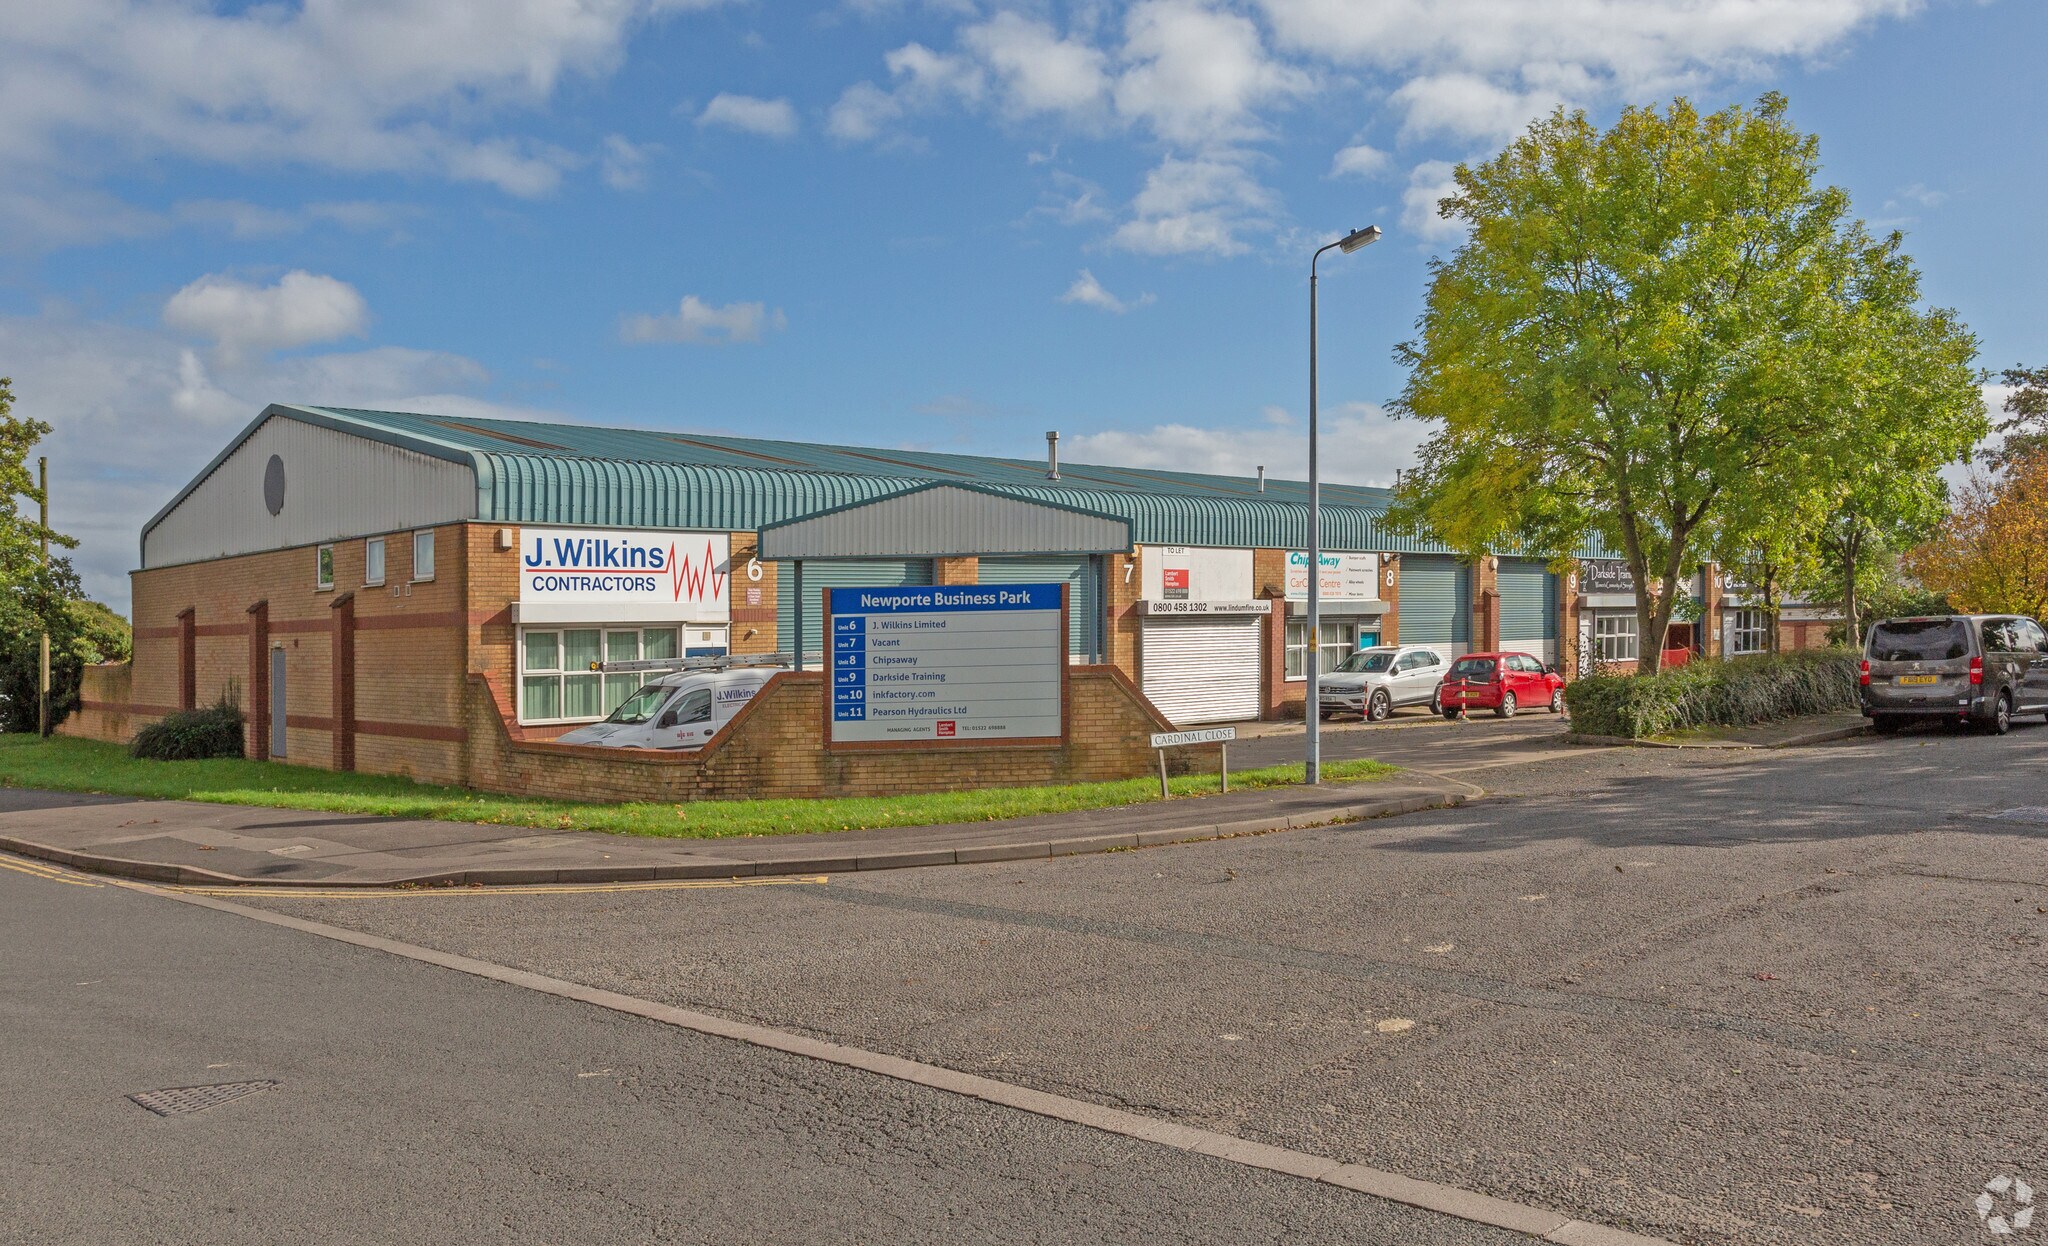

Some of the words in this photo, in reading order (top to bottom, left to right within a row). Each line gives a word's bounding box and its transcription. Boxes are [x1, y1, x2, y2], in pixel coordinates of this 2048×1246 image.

[526, 538, 664, 568] J.Wilkins
[748, 558, 762, 581] 6
[1124, 564, 1133, 583] 7
[1592, 565, 1616, 580] Darkside
[1616, 566, 1632, 580] Train
[1320, 578, 1341, 588] Centre
[1386, 569, 1393, 587] 8
[1570, 574, 1576, 590] 9
[1714, 576, 1721, 588] 10
[532, 576, 656, 592] CONTRACTORS
[862, 593, 930, 610] Newporte
[935, 592, 995, 606] Business
[1000, 590, 1030, 604] Park
[1154, 603, 1172, 612] 0800
[1174, 603, 1187, 611] 458
[1190, 603, 1207, 611] 1302
[849, 621, 856, 630] 6
[881, 620, 912, 629] Wilkins
[914, 620, 946, 628] Limited
[850, 638, 856, 648] 7
[849, 656, 856, 665] 8
[873, 656, 917, 666] Chipsaway
[849, 673, 856, 682] 9
[873, 672, 910, 681] Darkside
[912, 672, 945, 682] Training
[850, 690, 862, 699] 10
[873, 689, 935, 700] inkfactory.com
[850, 708, 862, 717] 11
[873, 707, 906, 716] Pearson
[908, 706, 952, 717] Hydraulics
[954, 706, 967, 714] Ltd
[1155, 732, 1201, 745] CARDINAL
[1205, 729, 1232, 740] CLOSE
